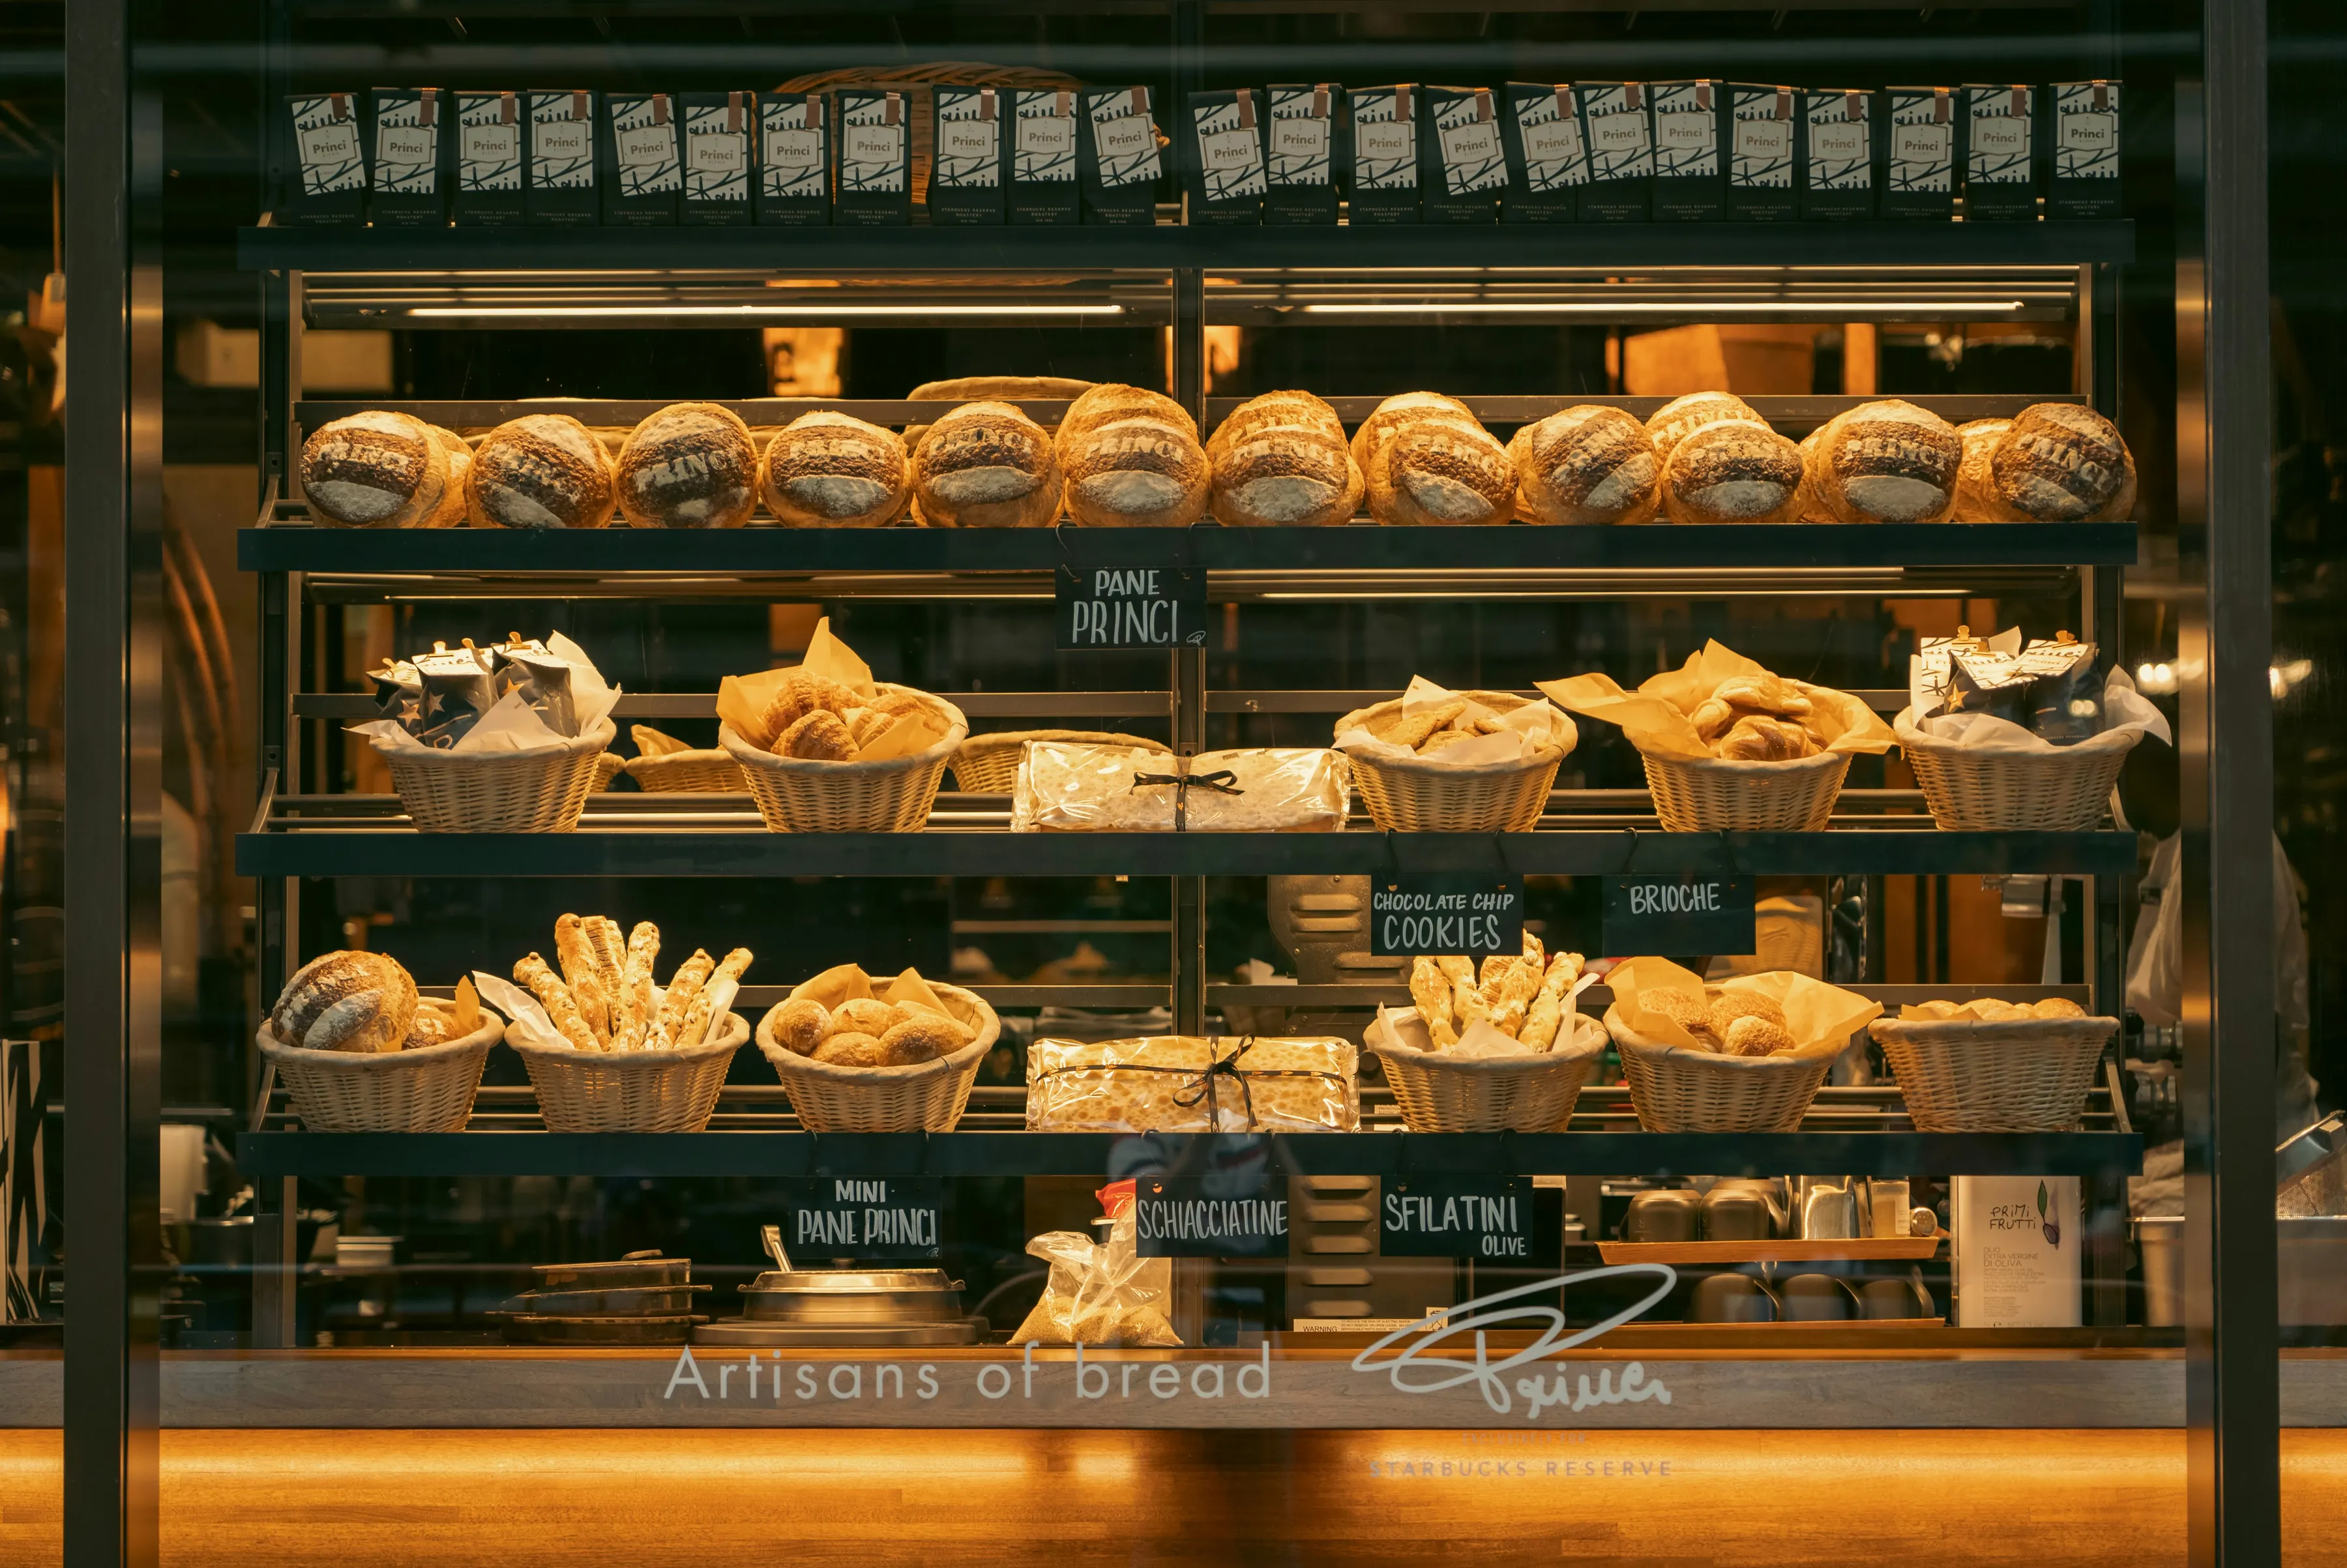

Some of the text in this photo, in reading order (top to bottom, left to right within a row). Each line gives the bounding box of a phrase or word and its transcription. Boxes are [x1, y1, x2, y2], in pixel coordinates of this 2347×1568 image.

[1029, 132, 1062, 142] Princi
[1108, 131, 1142, 145] Princi
[1283, 134, 1316, 145] Princi
[1602, 128, 1636, 140] Princi
[1669, 128, 1702, 138] Princi
[1983, 132, 2017, 143] Princi
[2071, 128, 2104, 139] Princi
[312, 140, 347, 154] Princi
[390, 142, 423, 153] Princi
[473, 140, 507, 151] Princi
[545, 136, 579, 147] Princi
[630, 141, 664, 155] Princi
[857, 141, 890, 151] Princi
[952, 136, 986, 147] Princi
[1369, 137, 1402, 148] Princi
[1454, 137, 1488, 153] Princi
[1536, 135, 1570, 151] Princi
[1746, 136, 1779, 147] Princi
[1822, 138, 1856, 149] Princi
[1905, 140, 1938, 151] Princi
[700, 149, 733, 160] Princi
[776, 145, 810, 156] Princi
[1214, 145, 1248, 159] Princi
[1085, 436, 1184, 463] PRINCI
[1095, 569, 1160, 597] PANE
[1072, 600, 1177, 644] PRINCI
[1374, 892, 1514, 911] CHOCOLATE CHIP
[1631, 883, 1720, 913] BRIOCHE
[1384, 913, 1501, 950] COOKIES
[835, 1179, 886, 1203] MINI
[1137, 1198, 1288, 1239] SCHIACCIATINE
[1385, 1193, 1518, 1232] SFILATINI
[798, 1208, 936, 1246] PANE PRINCI
[1481, 1235, 1526, 1256] OLIVE
[664, 1340, 1270, 1400] Artisans of bread
[1369, 1460, 1672, 1478] STARBUCKS RESERVE
